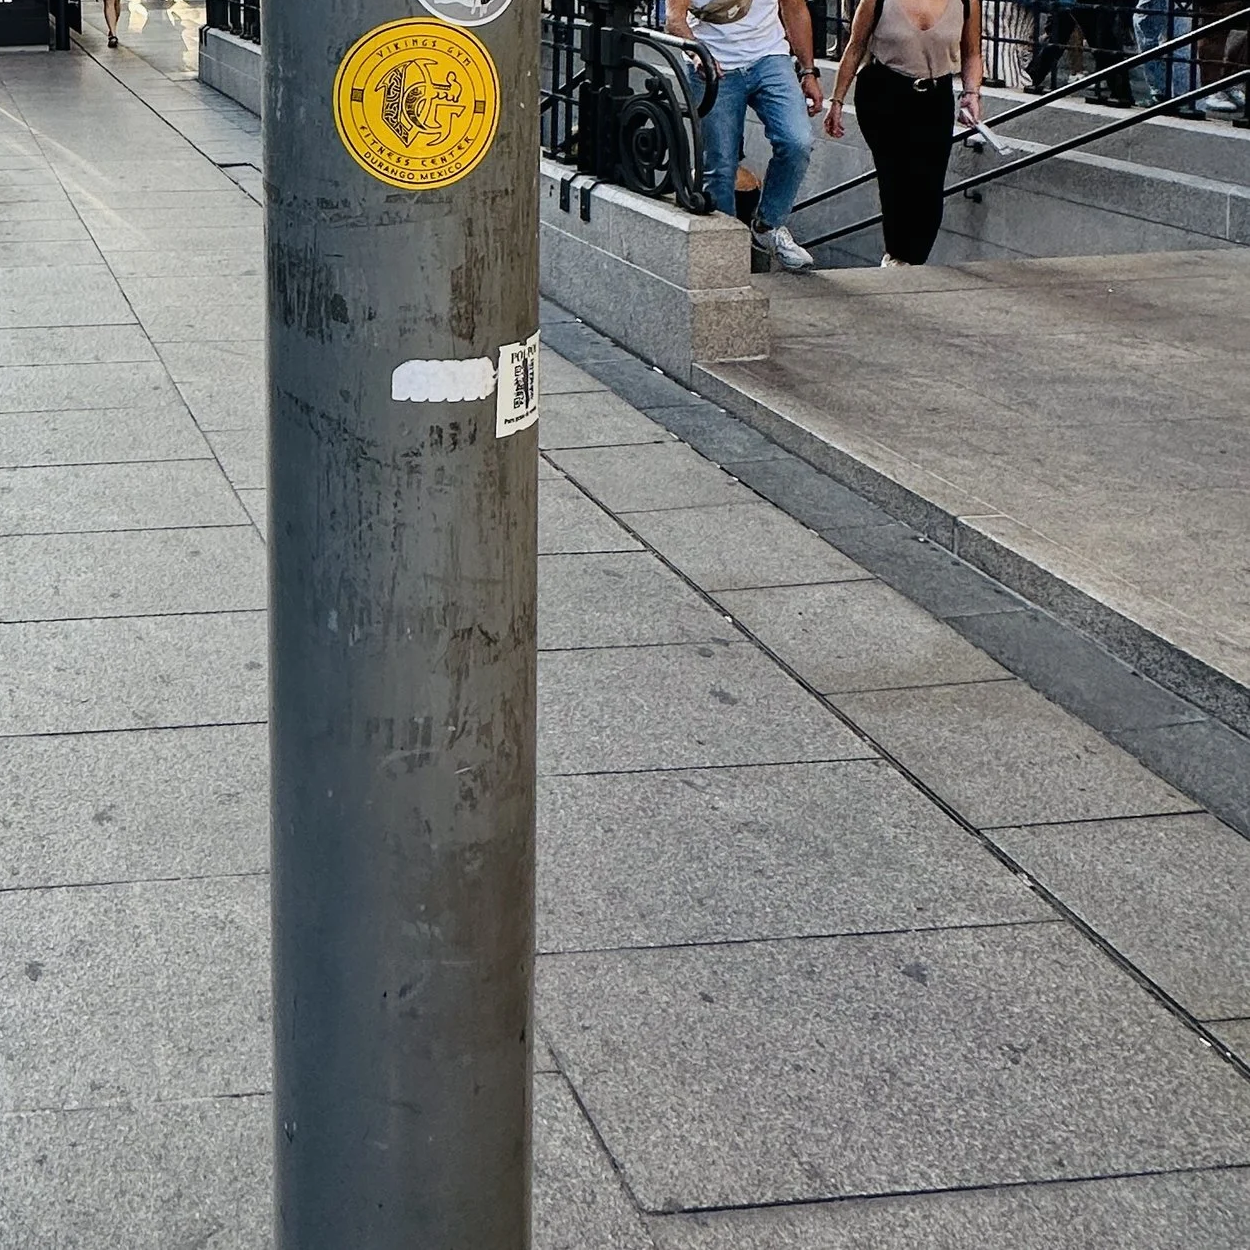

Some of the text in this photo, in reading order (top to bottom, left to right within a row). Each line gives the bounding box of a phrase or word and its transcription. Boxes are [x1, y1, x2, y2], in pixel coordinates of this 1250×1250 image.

[376, 38, 472, 67] VIKINGS GYM
[359, 124, 475, 168] FITNESS CENTER
[420, 162, 462, 181] MEXICO
